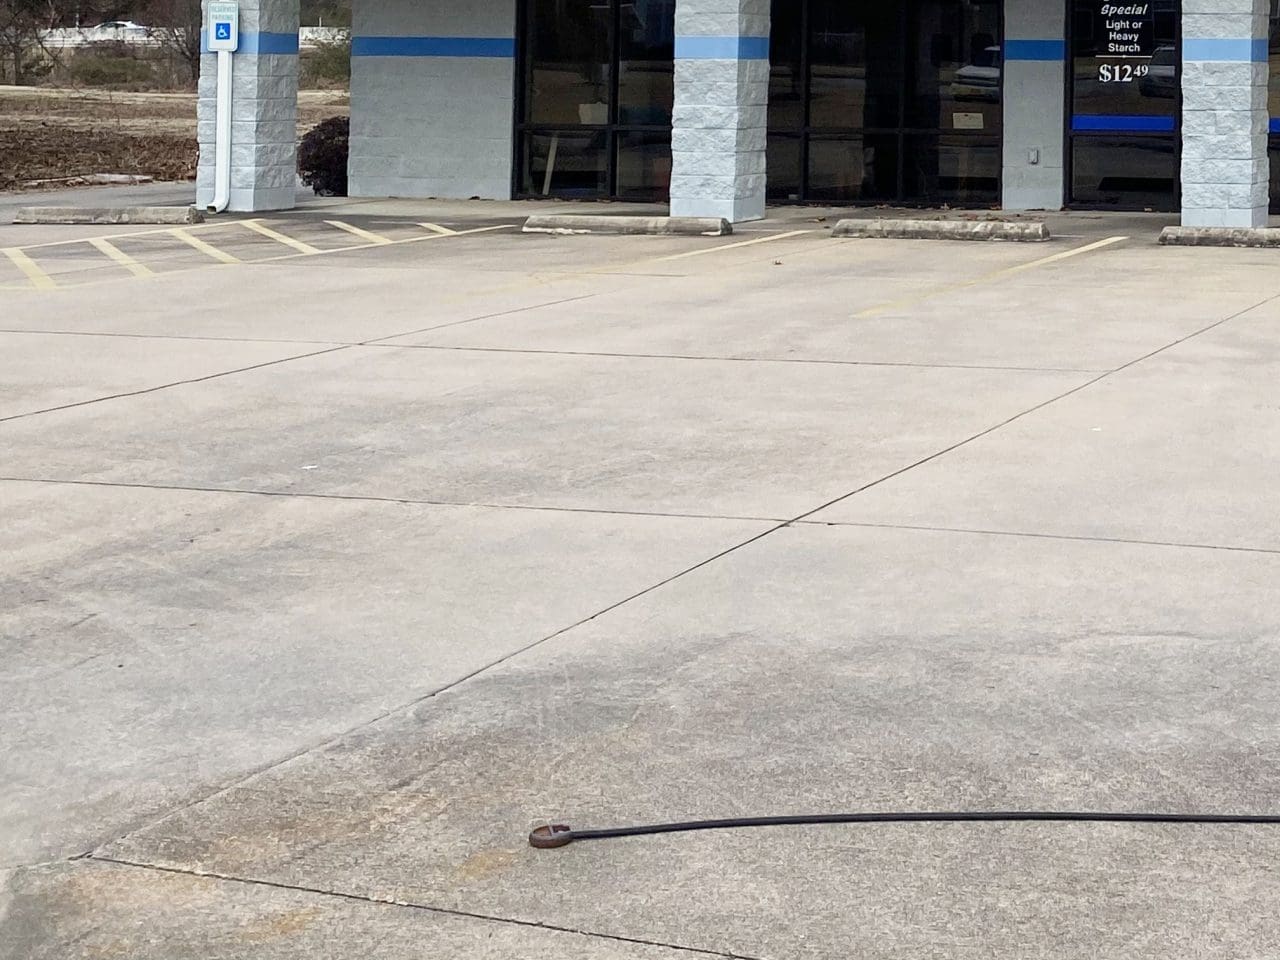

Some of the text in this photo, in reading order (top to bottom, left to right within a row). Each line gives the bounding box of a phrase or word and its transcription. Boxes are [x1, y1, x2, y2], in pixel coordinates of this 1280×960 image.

[1100, 3, 1148, 17] Special
[1105, 20, 1143, 31] Light or
[1109, 31, 1139, 42] Heavy
[1107, 43, 1141, 52] Starch
